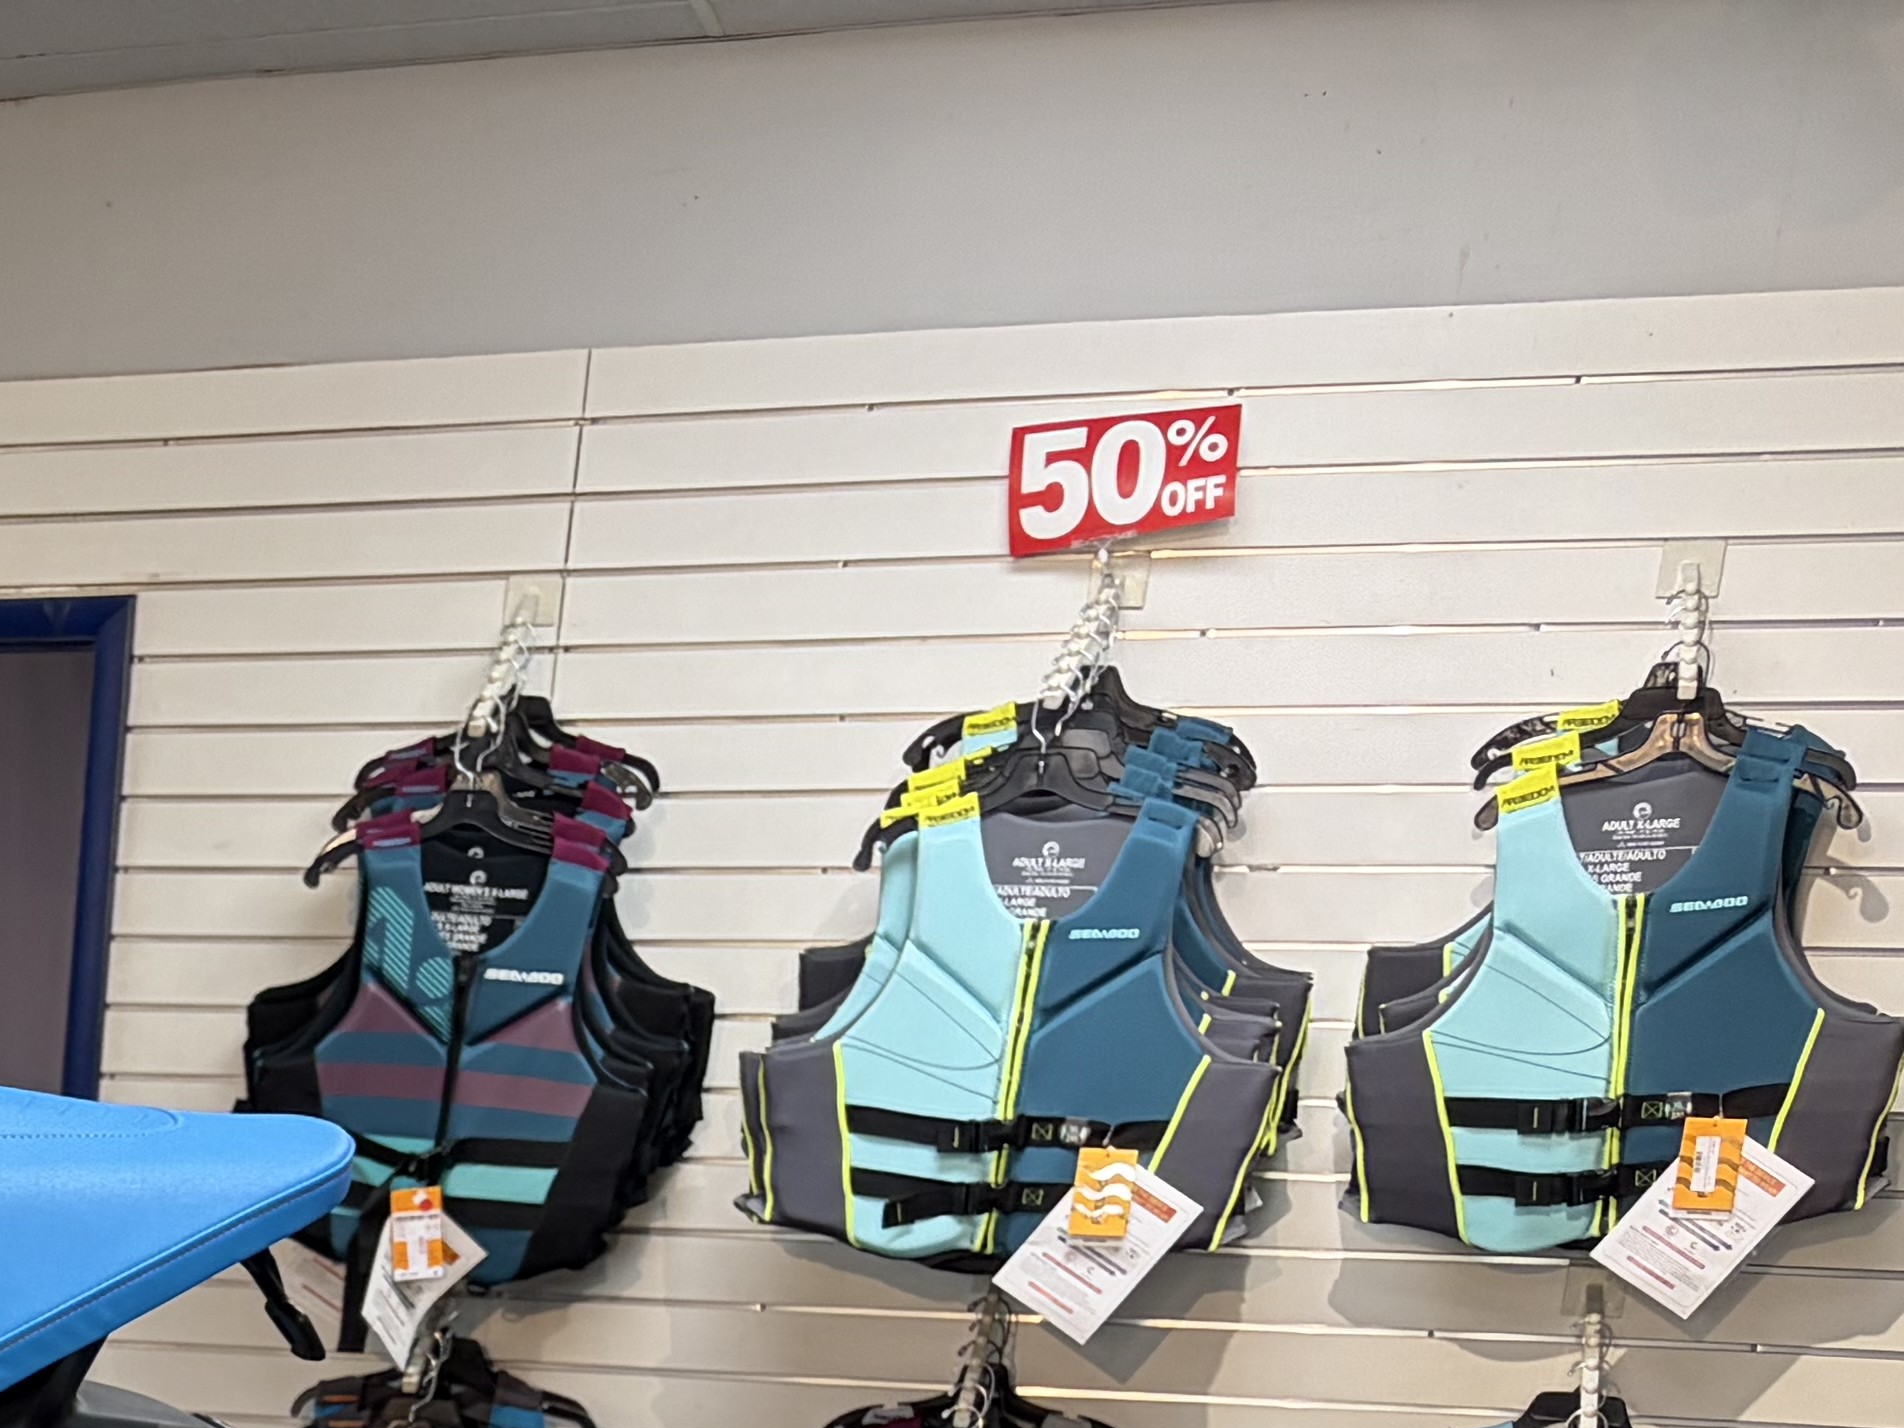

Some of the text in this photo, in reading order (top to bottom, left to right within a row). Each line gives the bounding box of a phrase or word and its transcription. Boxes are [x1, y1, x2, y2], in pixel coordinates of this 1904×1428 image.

[1018, 416, 1228, 540] 50%
[1161, 475, 1226, 517] OFF
[1602, 819, 1635, 832] ADULT
